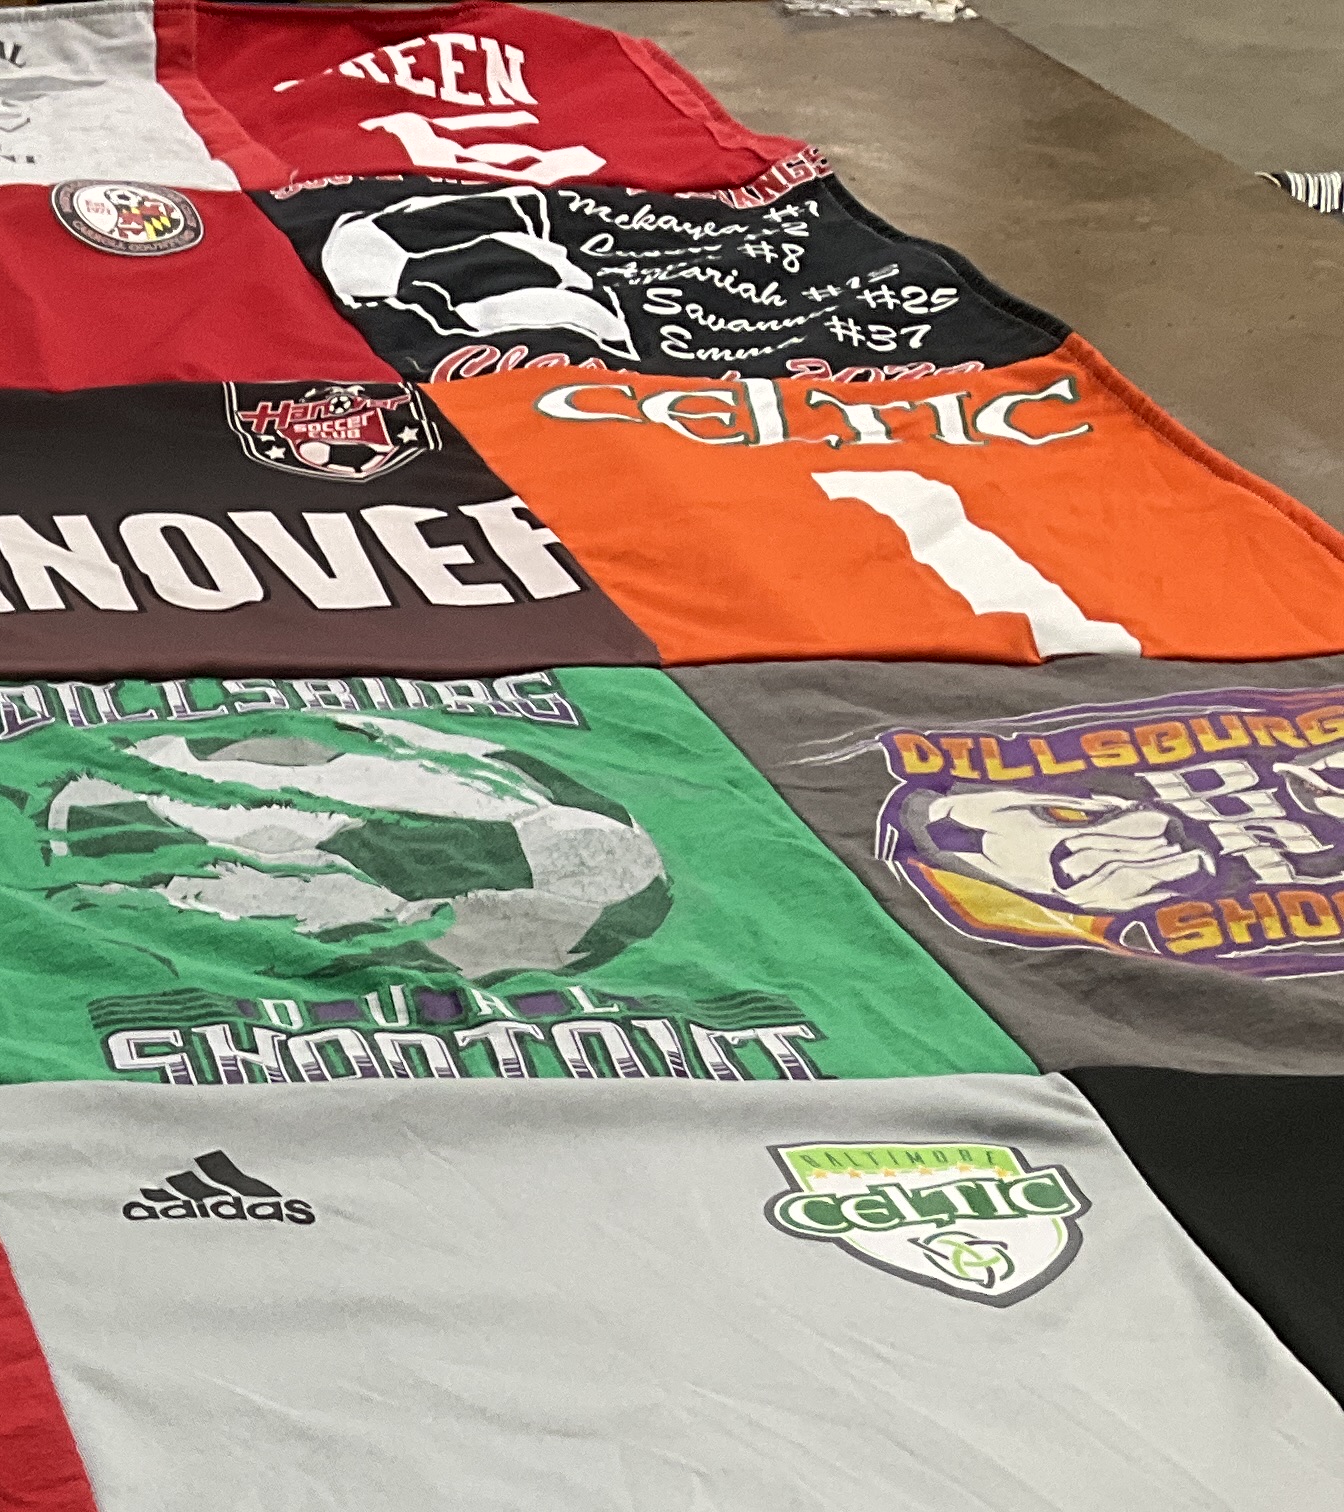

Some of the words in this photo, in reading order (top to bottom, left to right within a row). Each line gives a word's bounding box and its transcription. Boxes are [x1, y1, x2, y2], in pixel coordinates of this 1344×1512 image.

[736, 240, 806, 273] #8
[855, 283, 961, 315] #25
[823, 315, 932, 352] #37
[533, 376, 1092, 449] CELTIC
[811, 469, 1143, 659] 1
[892, 703, 1344, 783] DILLSBURG
[122, 1195, 316, 1226] adidas
[780, 1173, 1076, 1234] CELTIC
